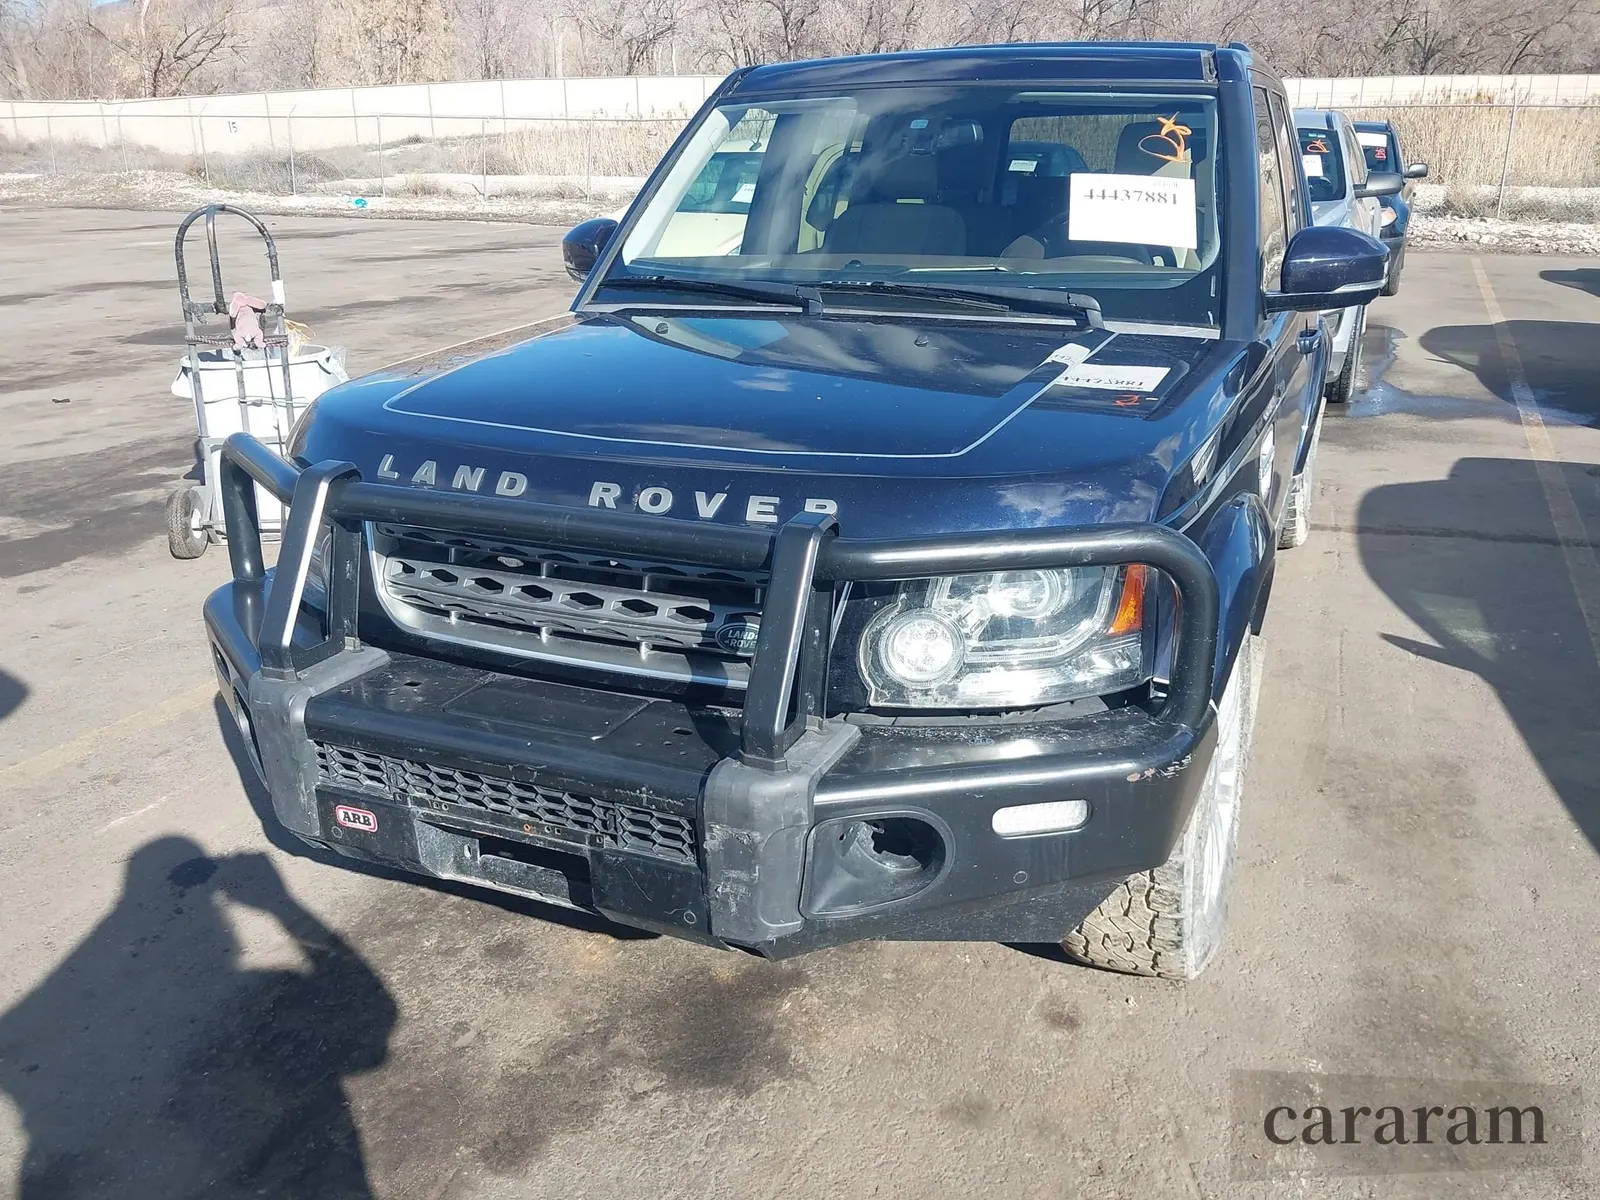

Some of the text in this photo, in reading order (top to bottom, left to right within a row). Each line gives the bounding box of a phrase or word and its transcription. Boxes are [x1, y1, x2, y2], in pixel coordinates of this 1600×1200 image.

[227, 120, 238, 134] 15
[1083, 188, 1178, 206] 44437881
[377, 453, 529, 497] LAND
[728, 629, 756, 640] LAND
[730, 639, 757, 649] ROVE
[342, 810, 372, 827] ARB
